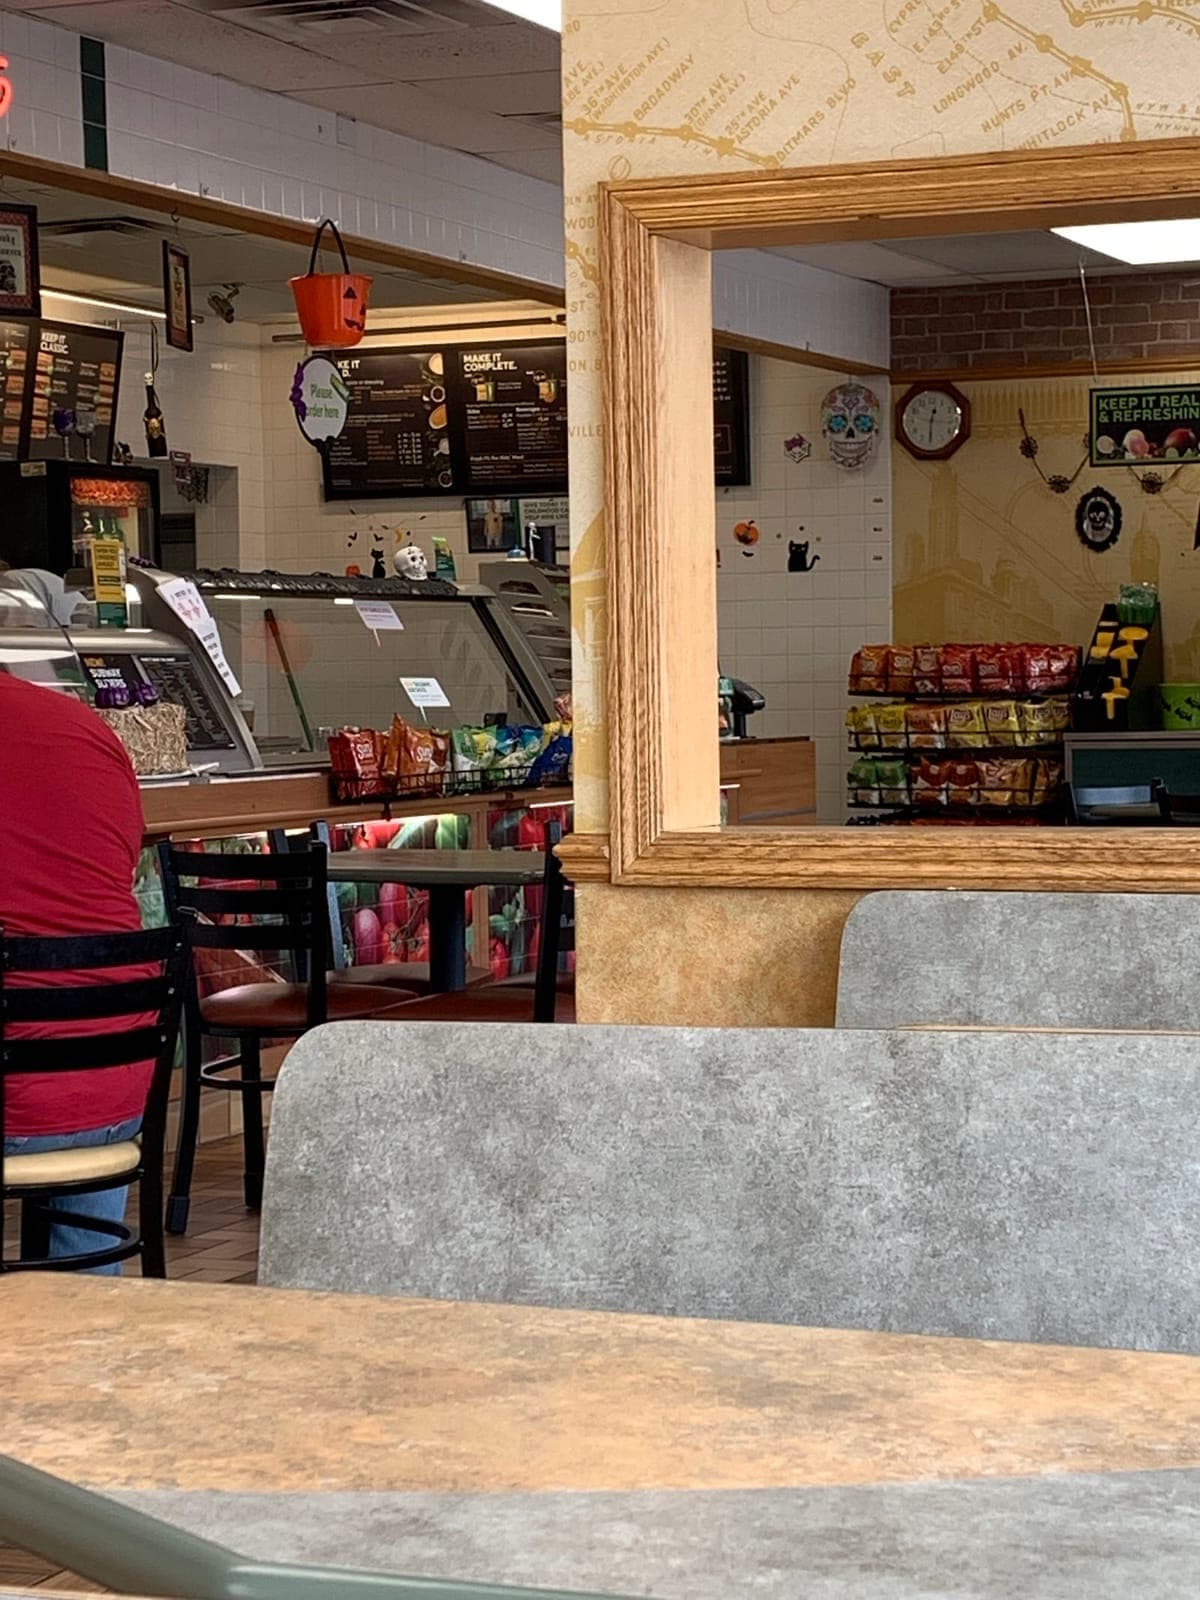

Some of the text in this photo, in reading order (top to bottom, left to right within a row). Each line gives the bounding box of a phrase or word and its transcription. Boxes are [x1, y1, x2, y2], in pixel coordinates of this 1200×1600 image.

[605, 63, 628, 90] AVE
[633, 53, 694, 121] BROADWAY
[708, 72, 729, 97] AVE
[933, 60, 1000, 114] LONGWOOD
[735, 74, 800, 145] ASTORIA AVE
[746, 90, 767, 113] AVE
[776, 78, 856, 162] DITMARS BLVD
[981, 98, 1026, 133] HUNTS
[351, 360, 361, 369] IT
[463, 352, 502, 363] MAKE IT
[463, 360, 518, 372] COMPLETE.
[311, 383, 333, 399] Please
[1098, 393, 1200, 411] KEEP IT REAL
[324, 403, 339, 418] here
[1098, 410, 1109, 423] &
